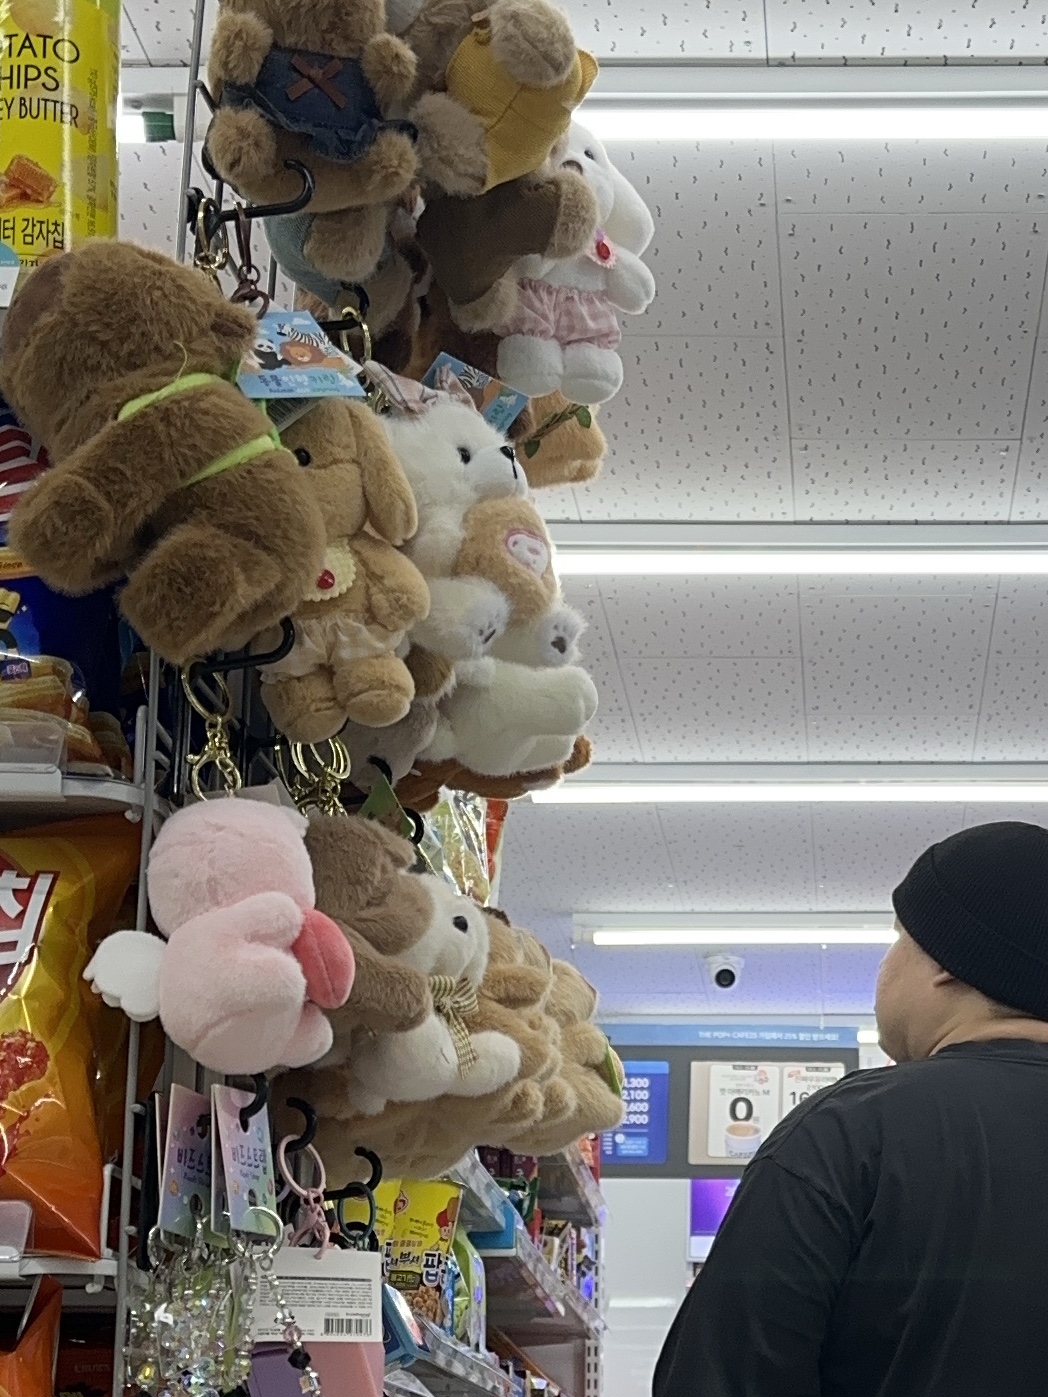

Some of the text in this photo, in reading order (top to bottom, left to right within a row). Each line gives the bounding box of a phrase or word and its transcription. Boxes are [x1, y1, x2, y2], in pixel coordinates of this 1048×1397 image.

[4, 34, 80, 64] TATO
[0, 64, 60, 92] HIPS
[19, 97, 79, 128] BUTTER
[0, 216, 65, 250] 터 감자칩
[729, 1096, 753, 1122] 0
